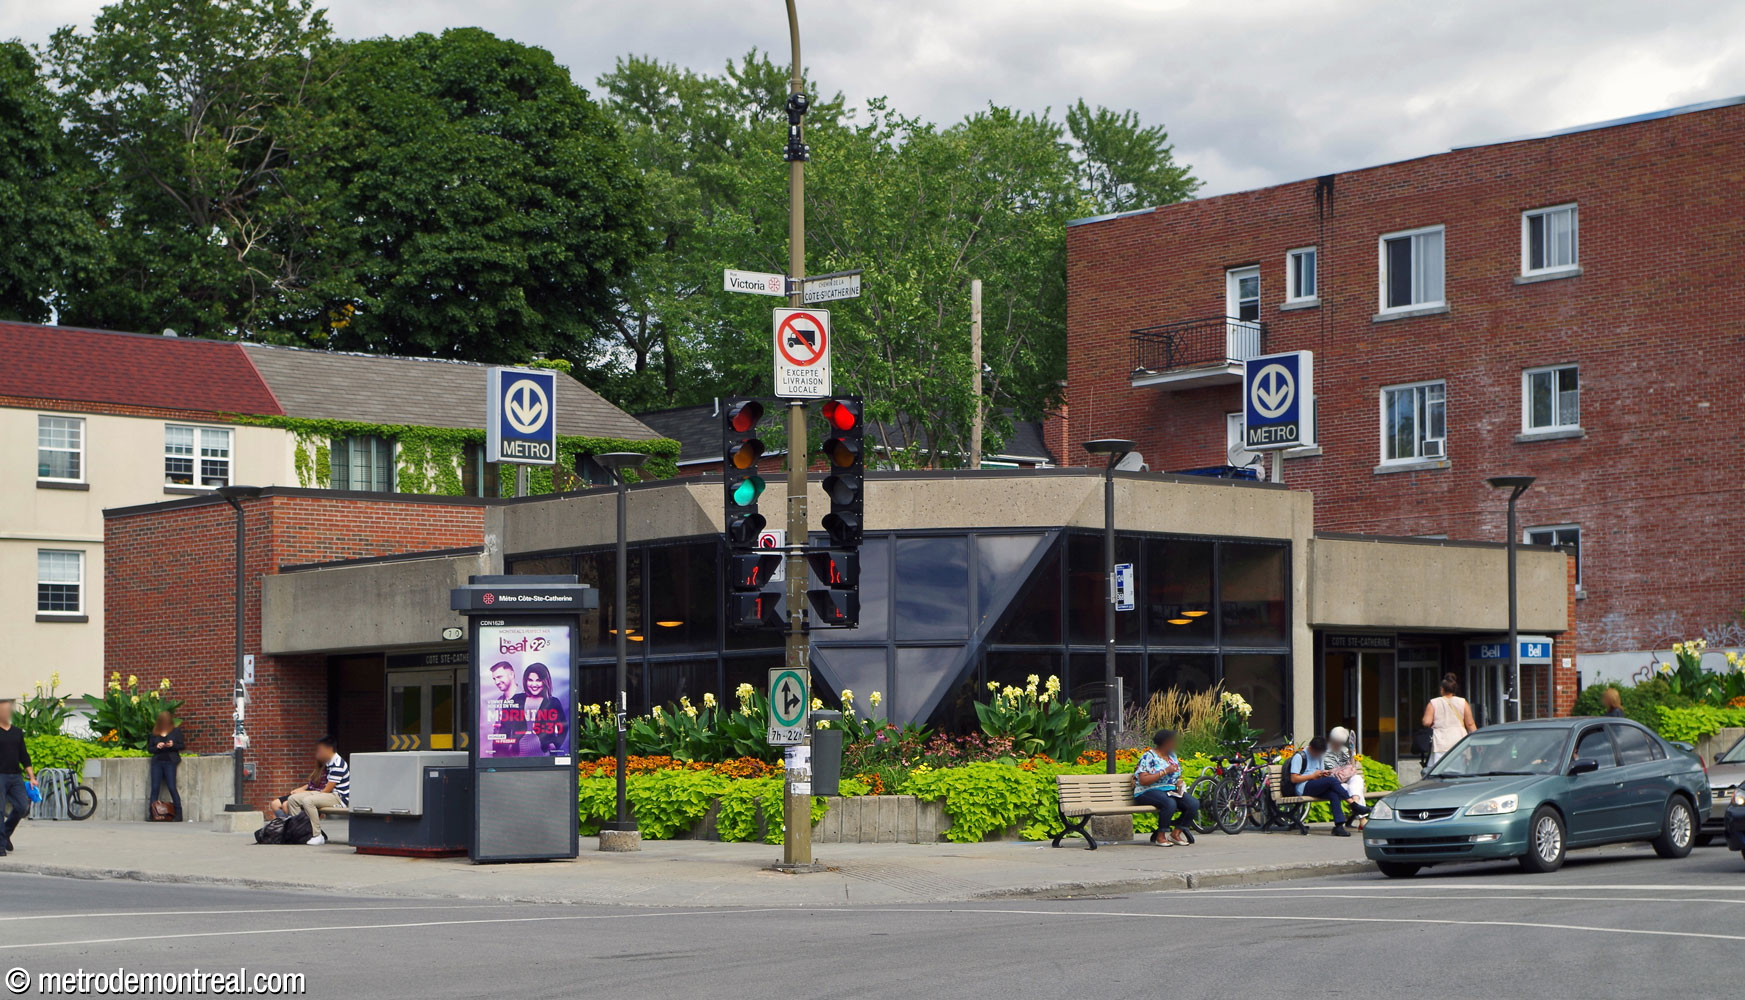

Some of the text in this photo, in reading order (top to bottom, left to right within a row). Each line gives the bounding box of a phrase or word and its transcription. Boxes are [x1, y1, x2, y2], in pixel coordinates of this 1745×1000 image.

[730, 277, 765, 290] Victoria
[499, 637, 528, 654] beat
[1481, 645, 1500, 658] Bell
[1528, 643, 1541, 657] Bell
[487, 709, 558, 722] MORNING
[532, 722, 564, 734] 5:30
